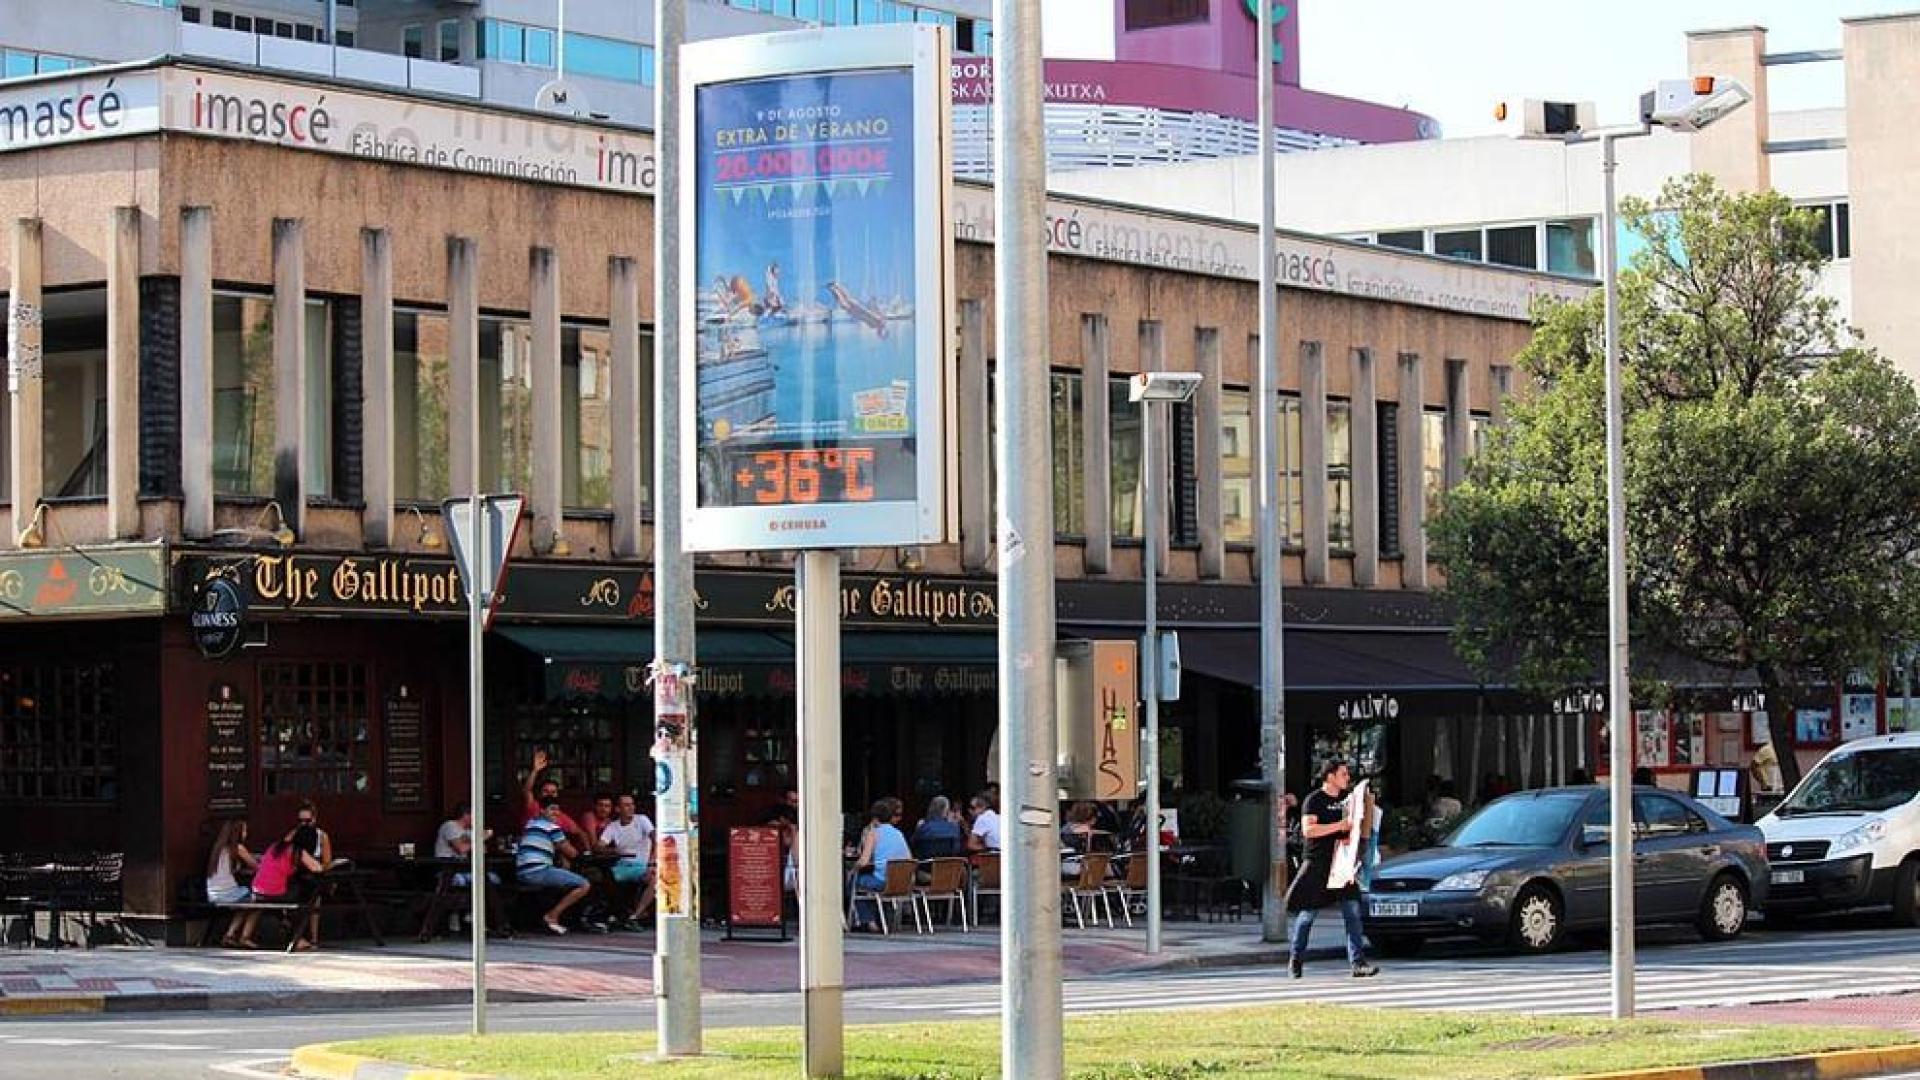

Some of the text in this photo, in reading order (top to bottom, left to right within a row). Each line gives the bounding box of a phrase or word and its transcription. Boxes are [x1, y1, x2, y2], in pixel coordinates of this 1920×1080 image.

[194, 77, 331, 145] imascé
[716, 118, 888, 147] EXTRA DE VERANO
[788, 104, 841, 119] AGOSTO
[352, 132, 419, 162] Fábrica
[424, 143, 448, 166] de
[453, 147, 577, 184] Comunicación
[735, 448, 874, 503] +36°C
[255, 555, 459, 613] The Gallipot
[870, 579, 967, 625] Gallipot
